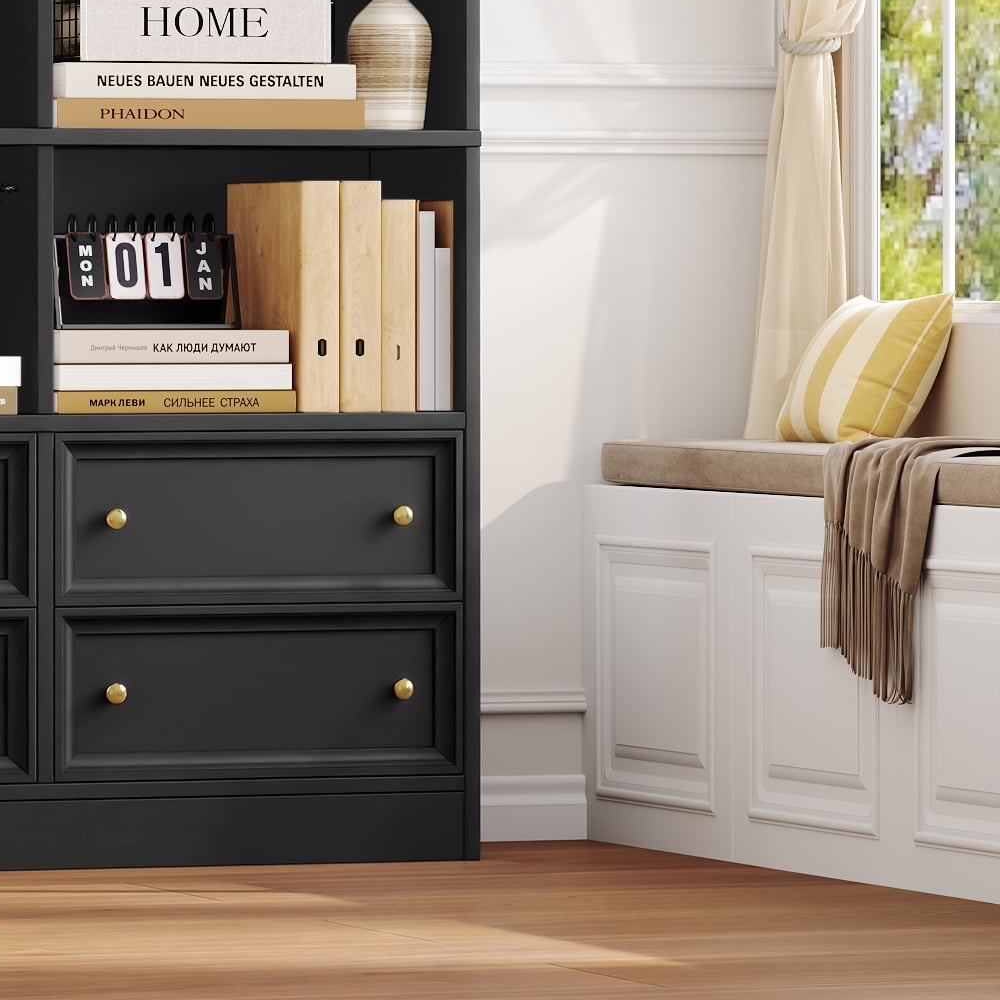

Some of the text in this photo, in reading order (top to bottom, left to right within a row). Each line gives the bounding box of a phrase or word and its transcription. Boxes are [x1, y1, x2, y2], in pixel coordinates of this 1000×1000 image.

[139, 6, 270, 38] HOME
[97, 74, 324, 88] NEUES BAUEN NEUES GESTALTEN
[100, 108, 185, 120] PHAIDON
[78, 244, 94, 287] MON
[195, 241, 213, 291] JAN
[153, 343, 173, 352] КАК
[176, 343, 208, 354] ЛЮДИ
[210, 342, 257, 354] ДУМАЮТ
[89, 397, 260, 408] МАРК ЛЕВИ СИЛЬНЕЕ СТРАХА
